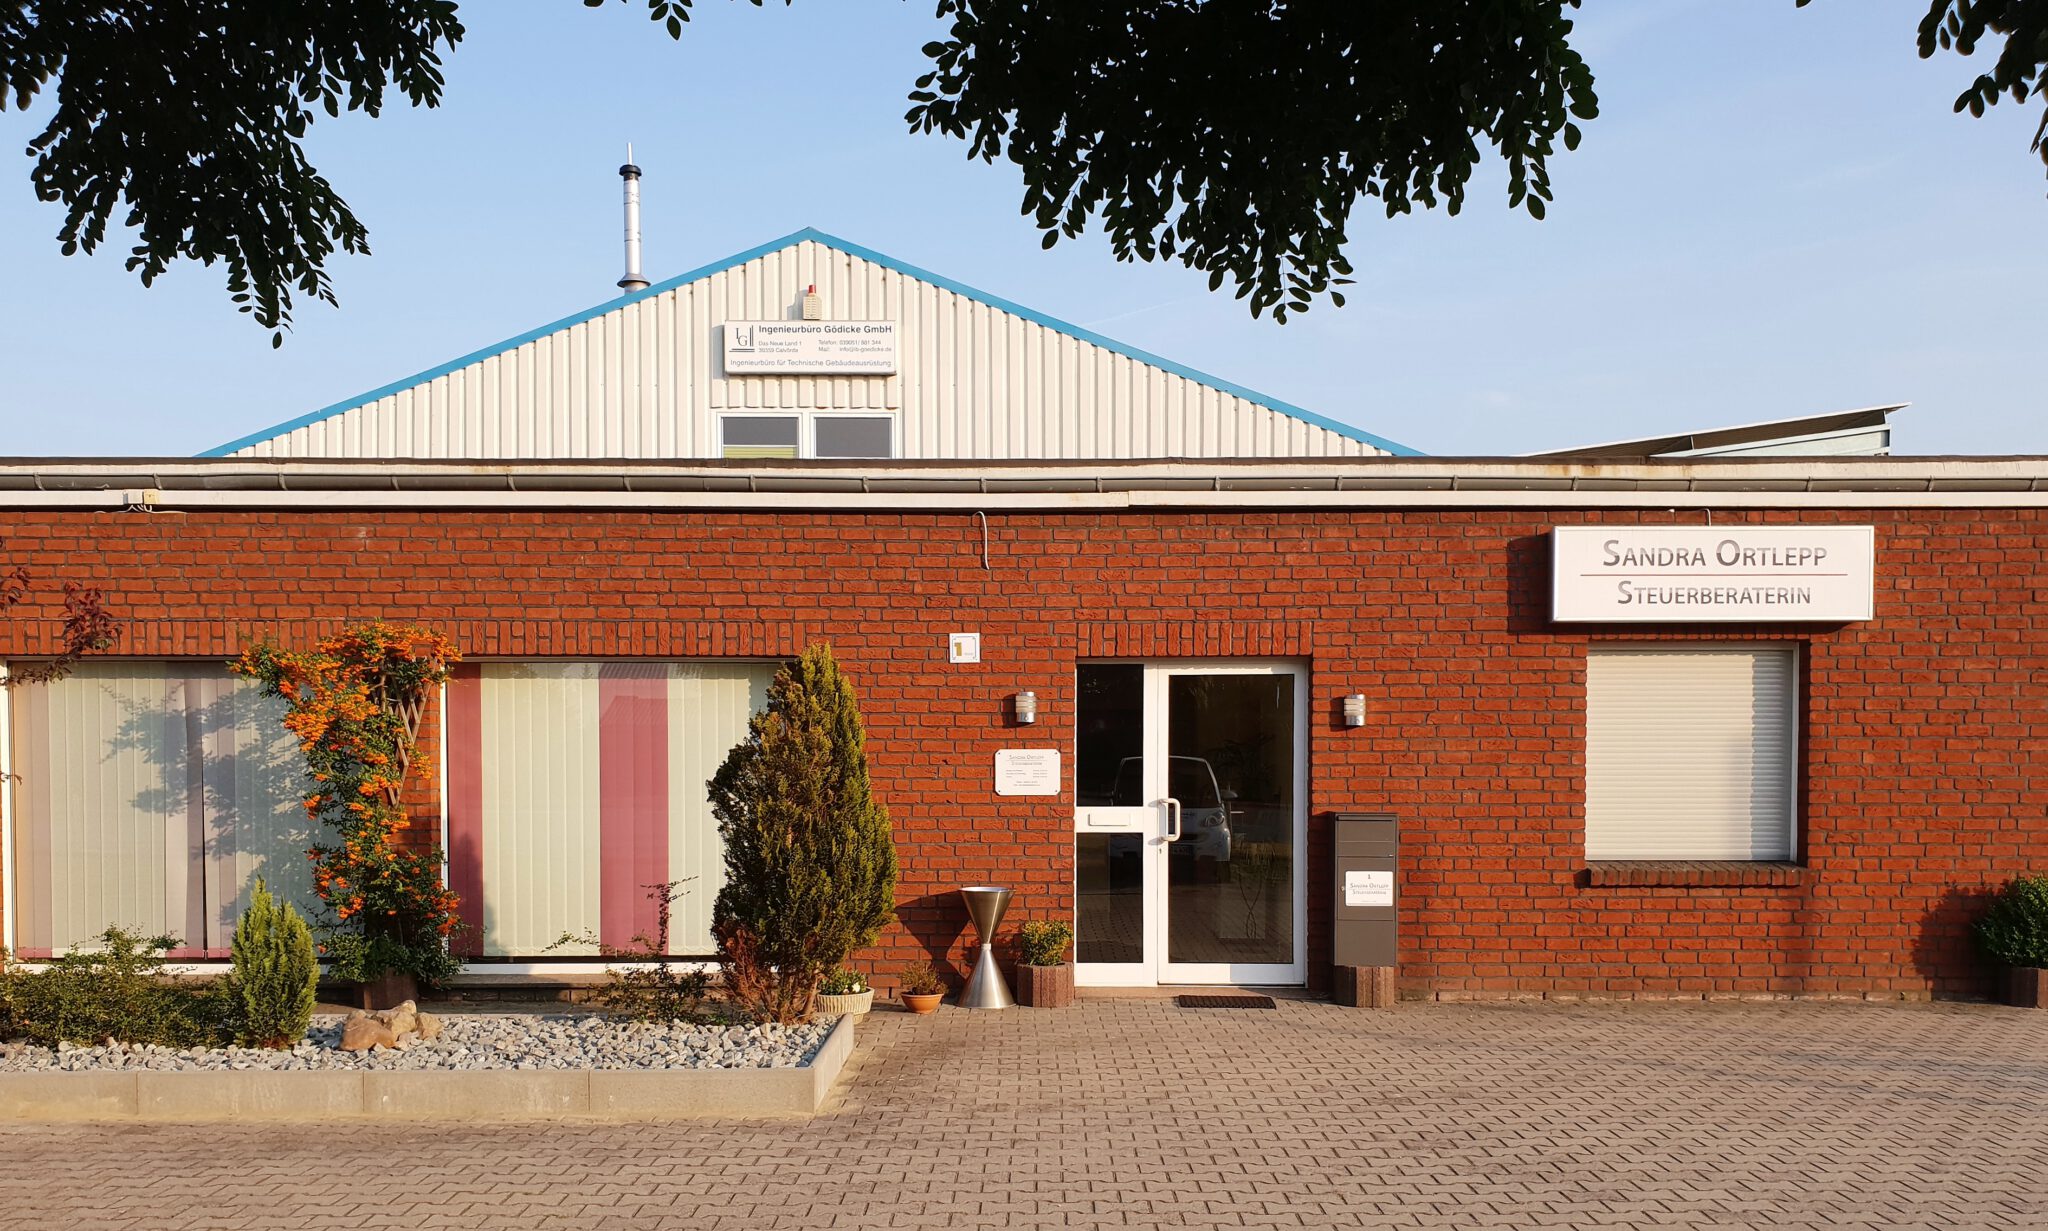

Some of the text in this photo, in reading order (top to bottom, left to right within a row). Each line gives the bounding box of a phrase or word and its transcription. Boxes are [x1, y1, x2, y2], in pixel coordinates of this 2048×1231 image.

[758, 325, 892, 335] Ingenieurbüro Gödicke GmbH
[730, 359, 776, 367] Ingenieurbüro
[825, 359, 892, 367] Gebäudeausrüstung
[1602, 539, 1828, 567] SANDRA ORTLEPP
[1617, 580, 1811, 605] STEUERBERATERIN
[954, 642, 962, 656] 1
